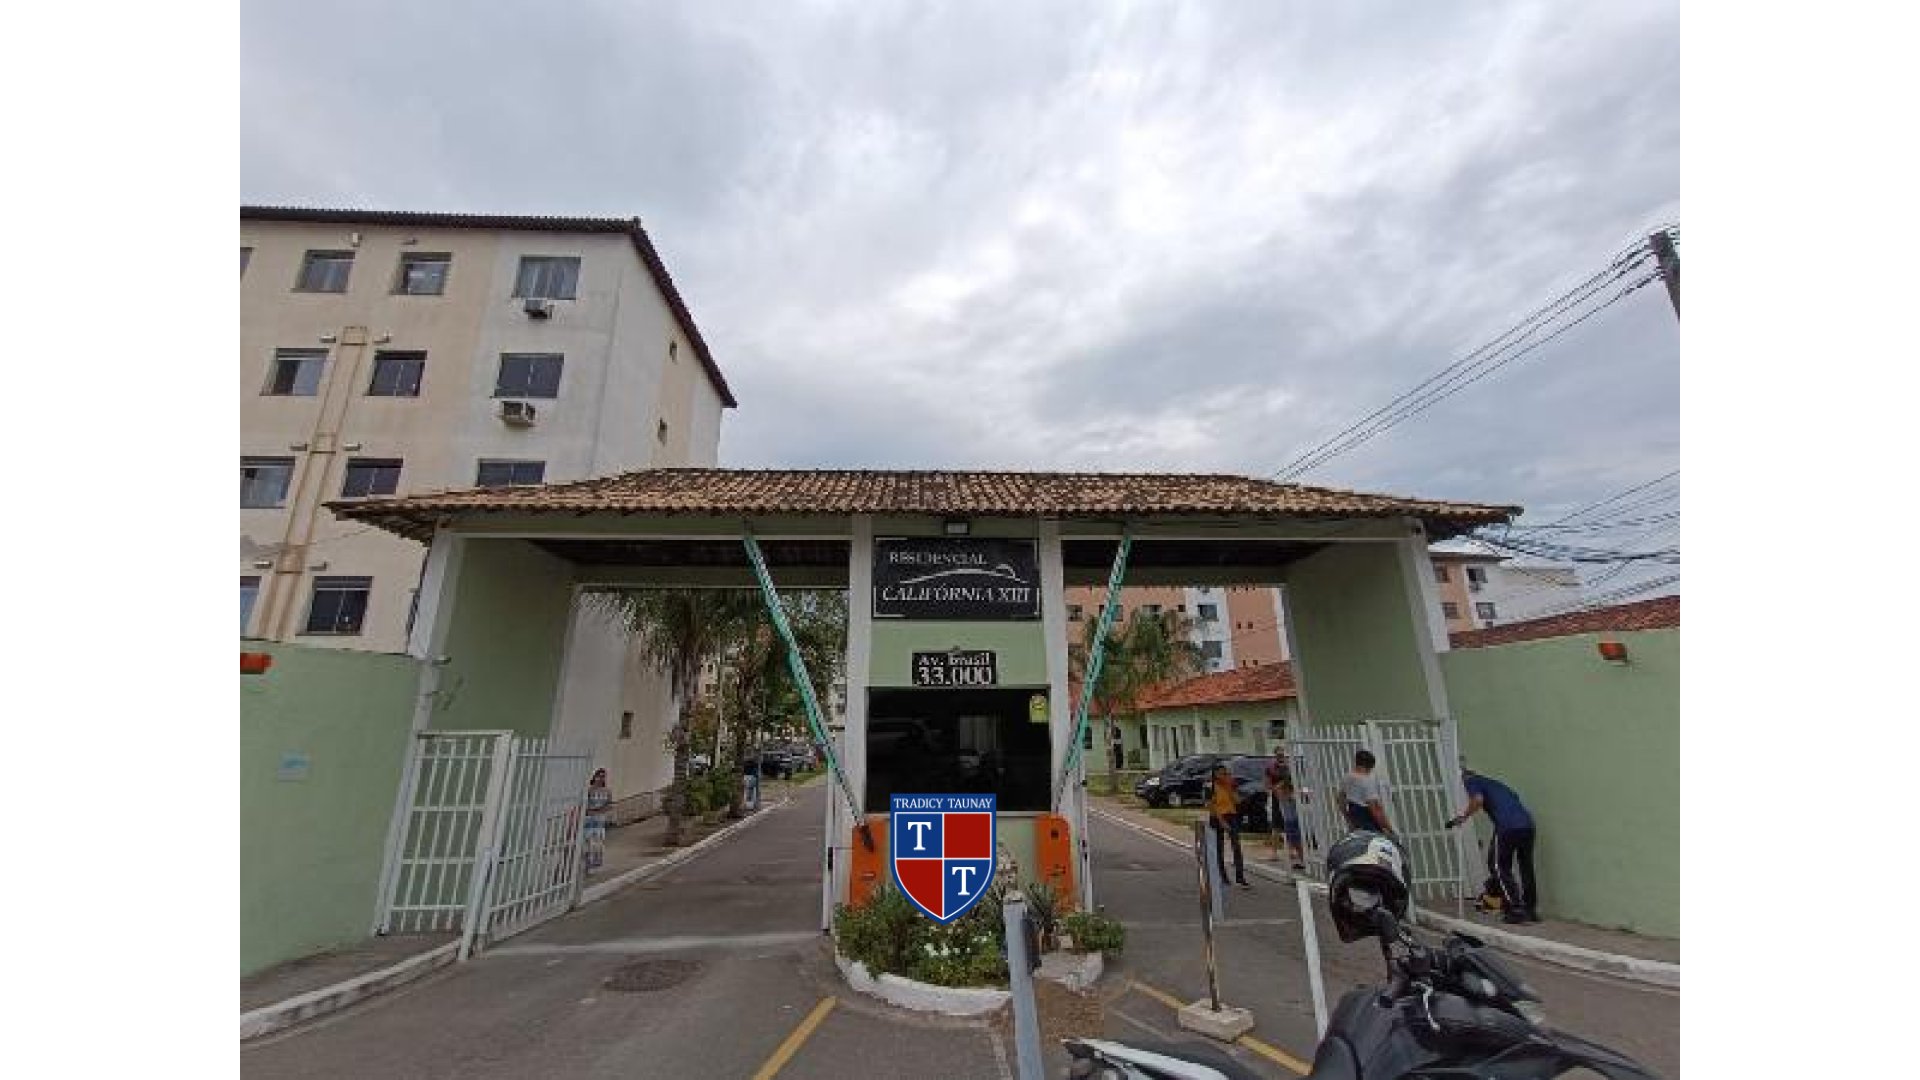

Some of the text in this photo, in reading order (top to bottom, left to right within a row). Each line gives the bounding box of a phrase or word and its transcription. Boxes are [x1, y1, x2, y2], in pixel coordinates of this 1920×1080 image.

[889, 551, 987, 565] RESIDENCIAL
[919, 655, 944, 666] Av.
[917, 666, 992, 685] 33.000
